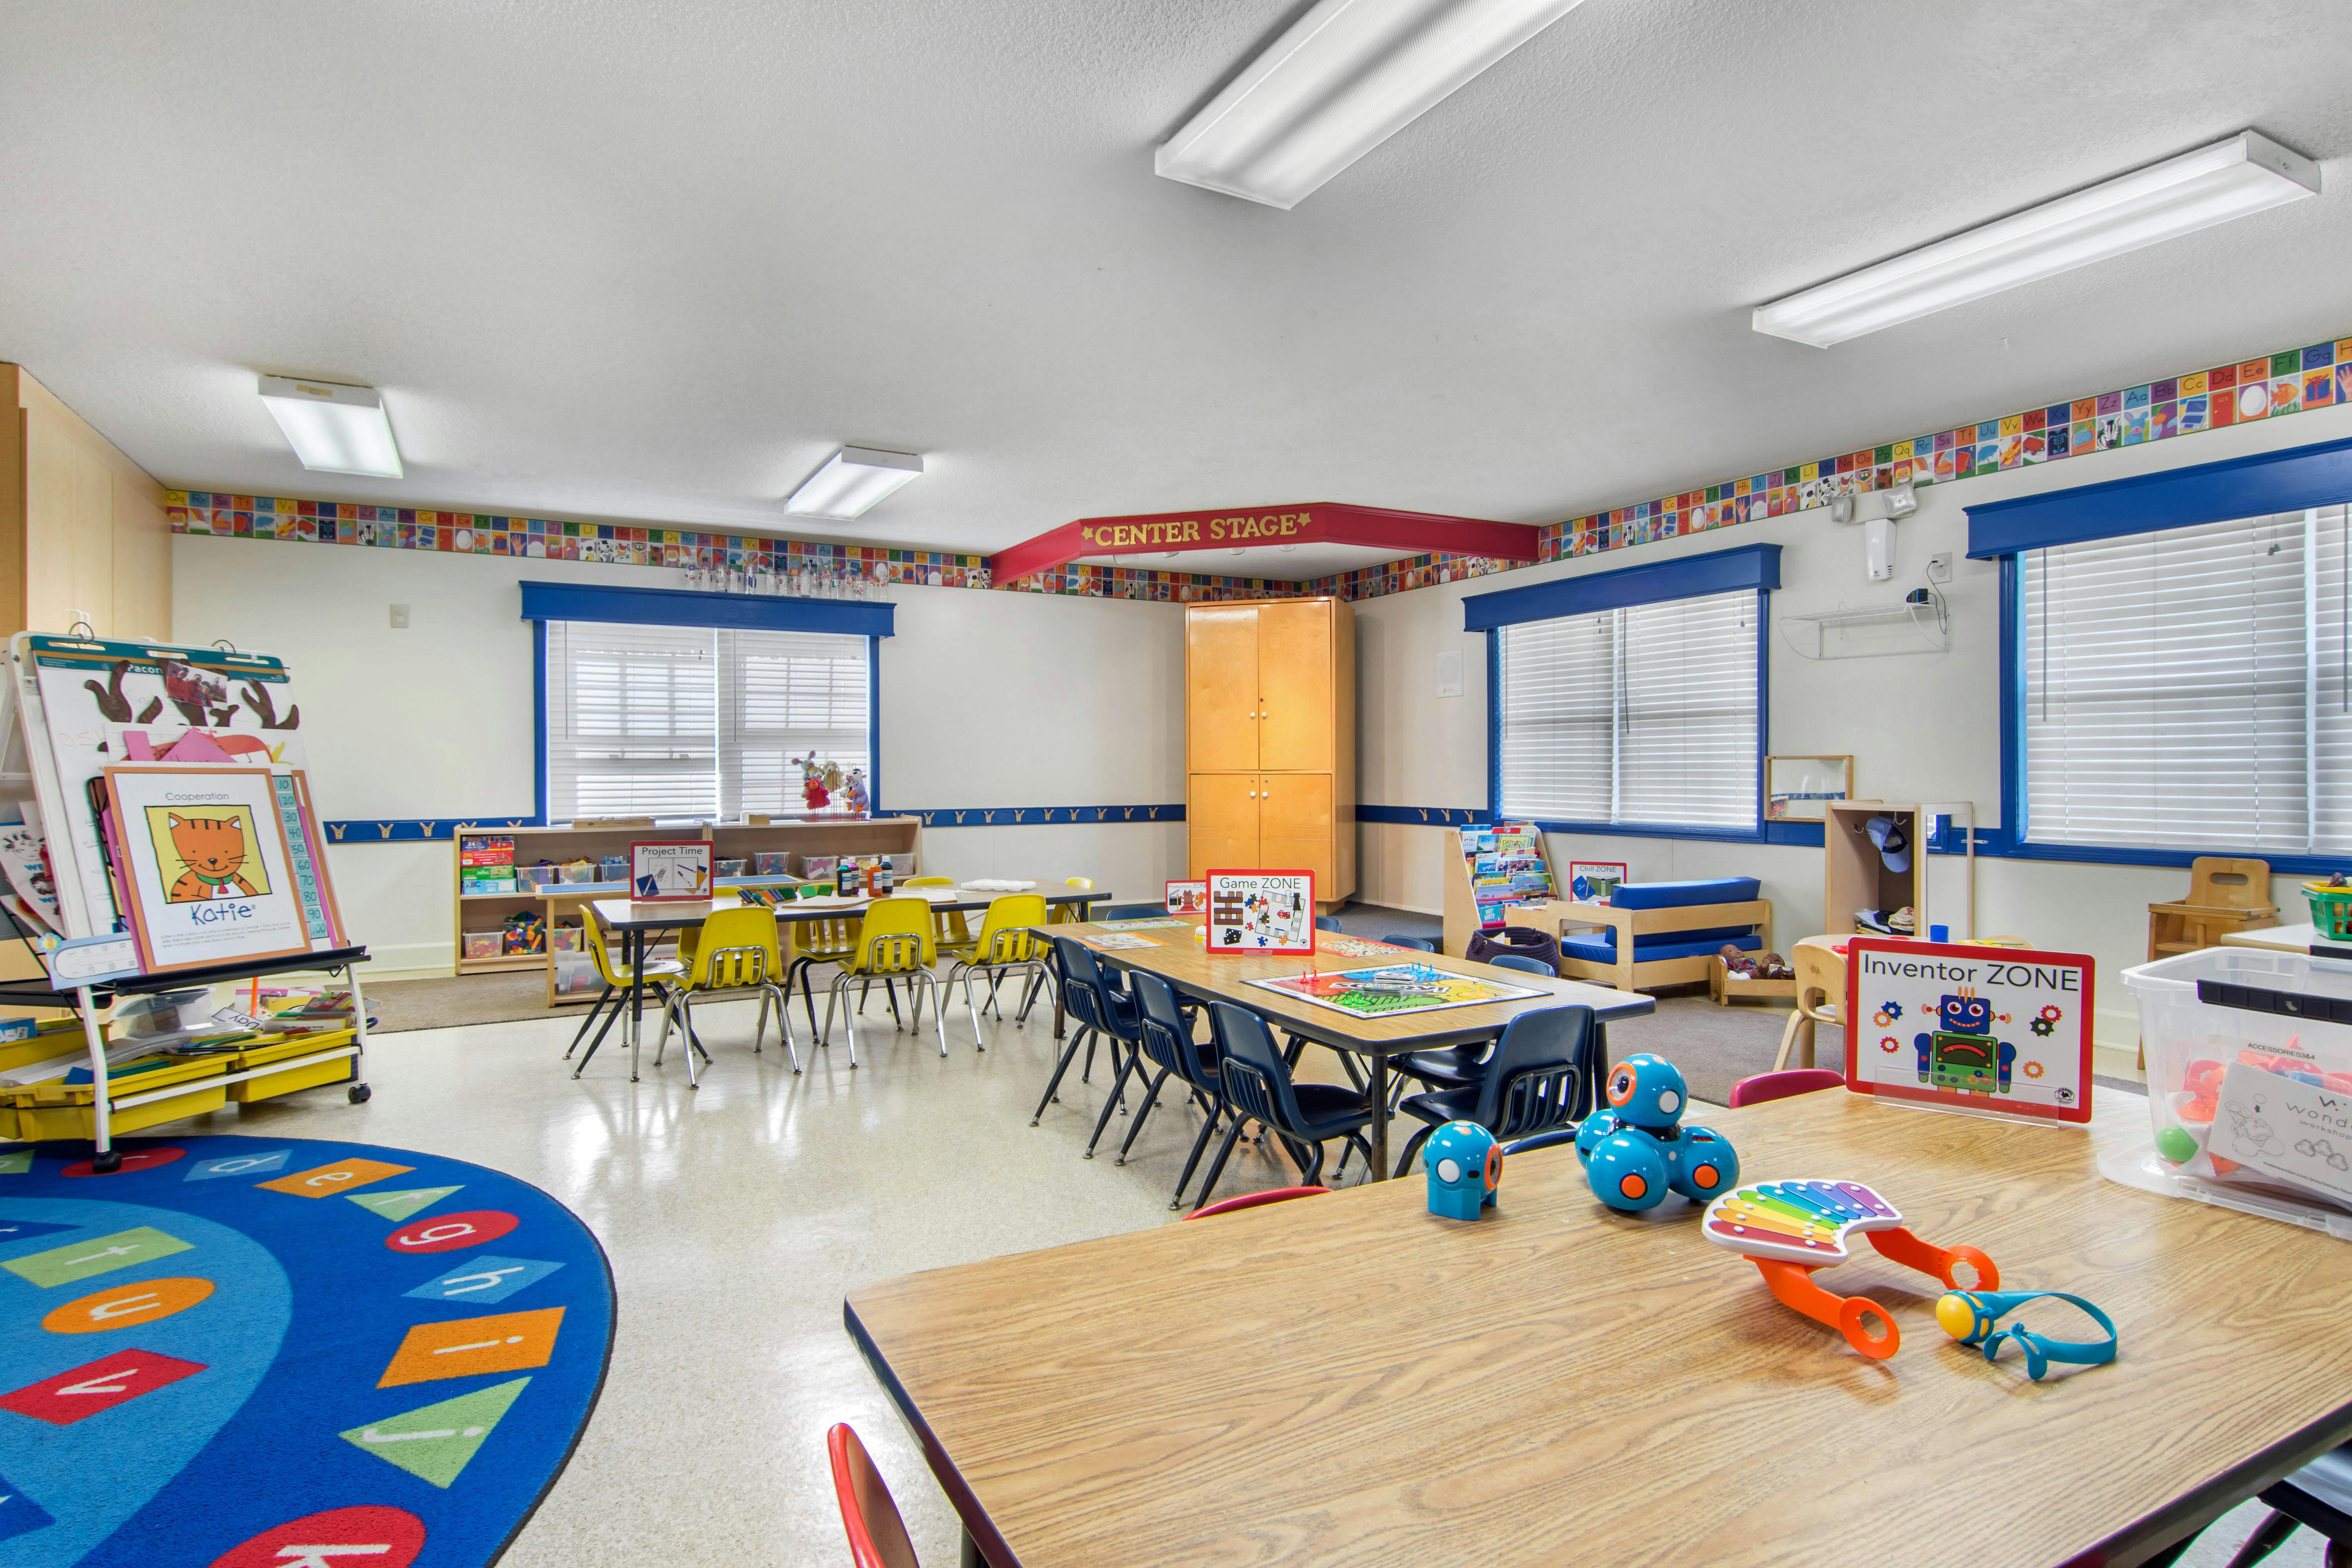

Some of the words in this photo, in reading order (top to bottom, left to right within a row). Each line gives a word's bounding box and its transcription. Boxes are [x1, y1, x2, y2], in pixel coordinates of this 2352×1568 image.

[1552, 526, 1560, 536] Tt
[1563, 523, 1572, 534] Uu
[1575, 522, 1583, 531] Vv
[1586, 519, 1597, 529] Ww
[1612, 513, 1621, 524] Yy
[1625, 509, 1633, 519] Zz
[1637, 505, 1648, 515] Aa
[1665, 499, 1675, 509] Cc
[1679, 495, 1689, 506] Dd
[1693, 493, 1703, 503] Ee
[1707, 489, 1717, 501] Ff
[1722, 486, 1733, 497] Gg
[1737, 482, 1749, 491] Hh
[1755, 478, 1762, 488] Ii
[1771, 474, 1780, 488] Jj
[1787, 470, 1798, 481] Kk
[1804, 466, 1813, 477] Ll
[1838, 459, 1853, 468] Nn
[1857, 454, 1871, 464] Oo
[1876, 449, 1890, 461] Pp
[1894, 445, 1912, 458] Qq
[1917, 441, 1930, 452] Rr
[1938, 436, 1950, 446] Ss
[1959, 429, 1973, 441] Tt
[1980, 425, 1995, 436] Uu
[2004, 420, 2018, 430] Vv
[2024, 415, 2045, 426] Ww
[2049, 408, 2067, 419] Xx
[2074, 405, 2092, 417] Yy
[2101, 397, 2117, 410] Zz
[2126, 392, 2147, 405] Aa
[2155, 385, 2174, 398] Bb
[2183, 378, 2203, 390] Cc
[2212, 371, 2234, 384] Dd
[2244, 364, 2263, 377] Ee
[2275, 354, 2296, 370] Ff
[2305, 349, 2331, 365] Gg
[167, 492, 185, 506] Qq
[192, 494, 206, 503] Rr
[237, 497, 250, 507] Tt
[258, 499, 272, 509] Uu
[279, 500, 293, 510] Vv
[341, 505, 354, 518] Yy
[361, 507, 373, 517] Zz
[381, 510, 395, 519] Aa
[420, 513, 432, 521] Cc
[458, 515, 470, 524] Ee
[512, 521, 525, 529] Hh
[549, 523, 559, 535] Jj
[584, 524, 592, 534] Ll
[617, 528, 629, 538] Nn
[633, 530, 645, 538] Oo
[650, 532, 661, 542] Pp
[666, 533, 678, 544] Qq
[682, 534, 694, 543] Rr
[715, 536, 724, 544] Tt
[791, 543, 800, 552] Yy
[820, 546, 831, 554] Aa
[933, 553, 937, 561] Ii
[945, 554, 953, 565] Jj
[1095, 521, 1201, 546] CENTER
[1210, 514, 1298, 540] STAGE
[279, 780, 289, 789] 10
[165, 792, 229, 801] Cooperation
[283, 796, 294, 805] 20
[284, 813, 297, 822] 30
[289, 827, 301, 838] 40
[292, 844, 304, 854] 50
[642, 847, 676, 857] Project
[679, 846, 703, 855] Time
[298, 860, 310, 870] 60
[301, 875, 314, 886] 70
[1220, 877, 1257, 889] Game
[1261, 877, 1301, 889] ZONE
[304, 891, 317, 902] 80
[191, 903, 252, 926] Katie
[308, 909, 321, 919] 90
[313, 924, 326, 933] 100
[1865, 954, 1977, 982] Inventor
[1987, 964, 2078, 991] ZONE
[2247, 1043, 2315, 1060] ACCESSORIES3&4
[2286, 1102, 2352, 1129] wond
[2299, 1119, 2352, 1140] workshop
[306, 1172, 354, 1187] e
[400, 1223, 477, 1245] g
[64, 1244, 140, 1266] t
[442, 1266, 524, 1296] h
[89, 1292, 162, 1321] u
[432, 1335, 524, 1354] i
[55, 1368, 139, 1396] v
[362, 1426, 484, 1443] j
